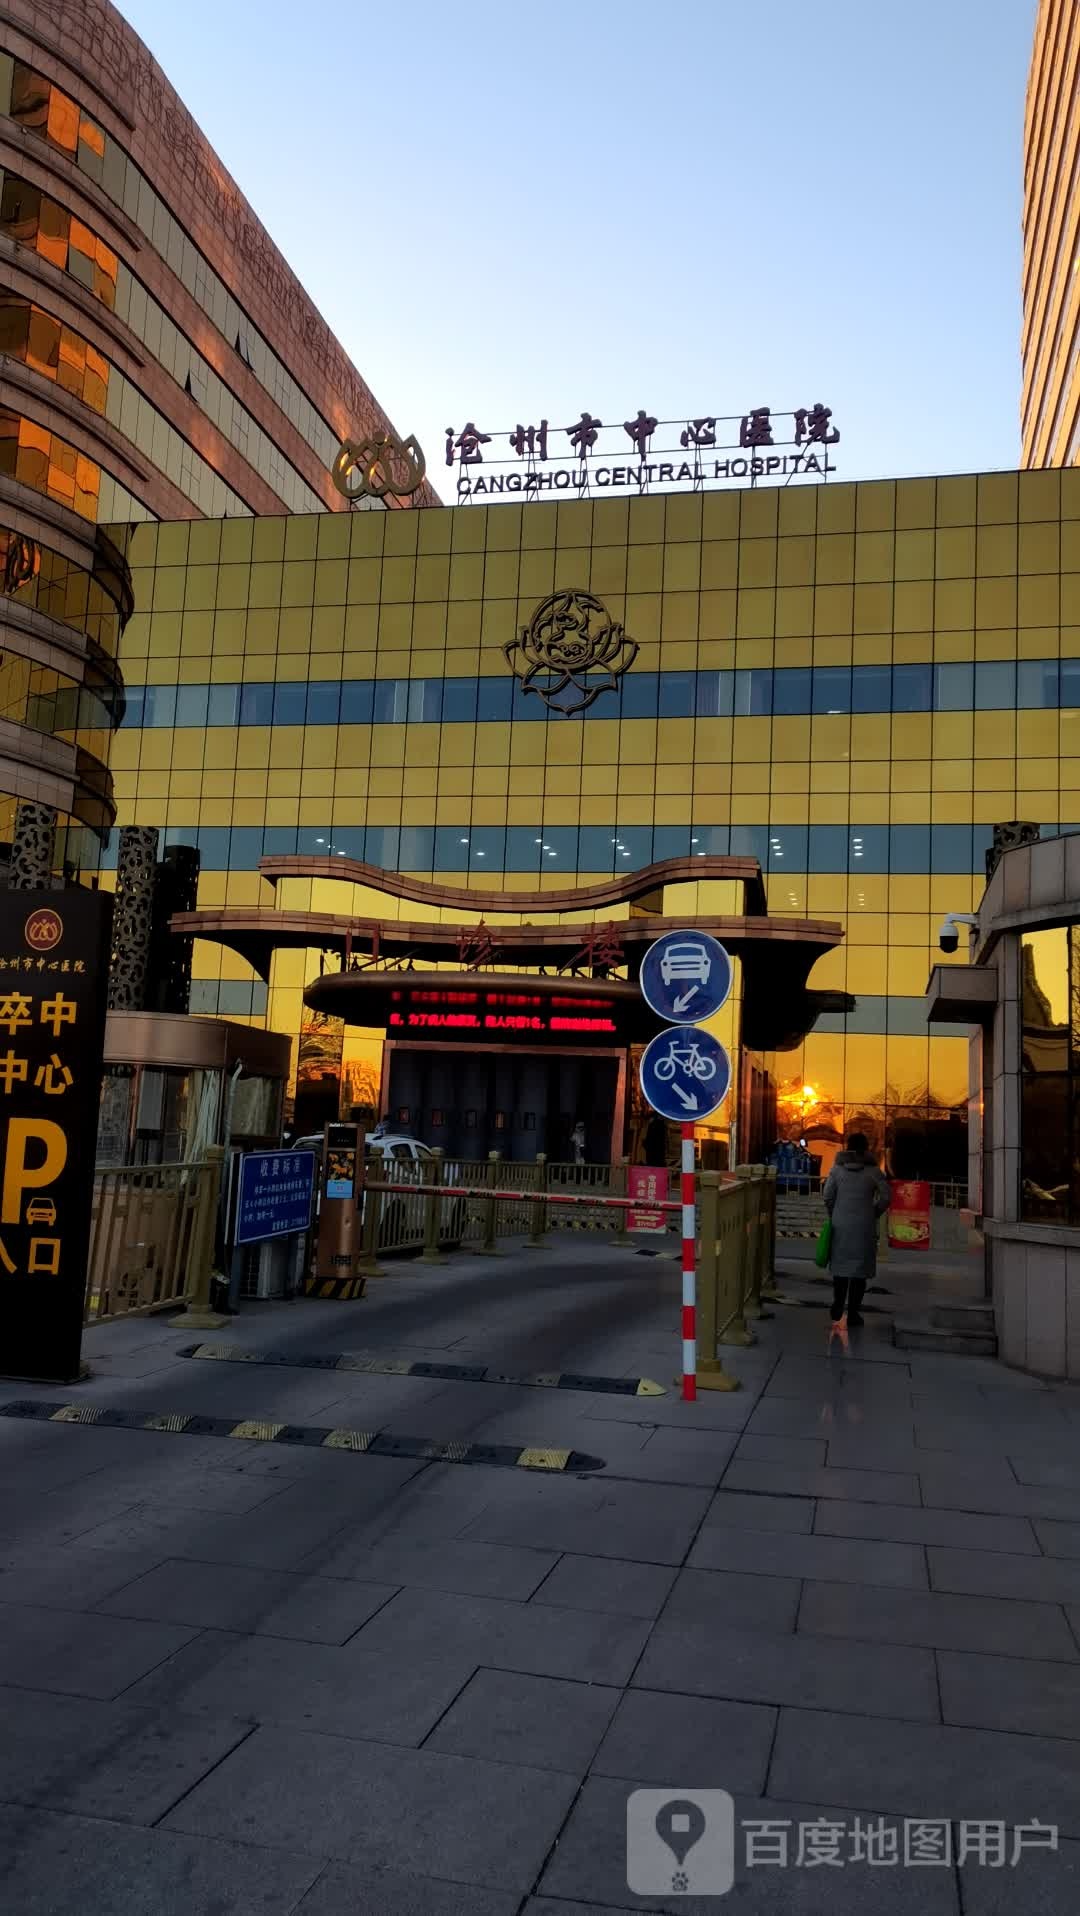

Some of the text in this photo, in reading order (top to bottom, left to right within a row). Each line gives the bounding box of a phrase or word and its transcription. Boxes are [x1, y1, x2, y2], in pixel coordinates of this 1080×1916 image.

[445, 403, 841, 466] 沧州市中心医院
[456, 452, 837, 496] CANGZHOU CENTRAL HOSPITAL
[0, 992, 77, 1037] 卒中
[0, 1050, 74, 1095] 中心
[1, 1117, 68, 1225] P
